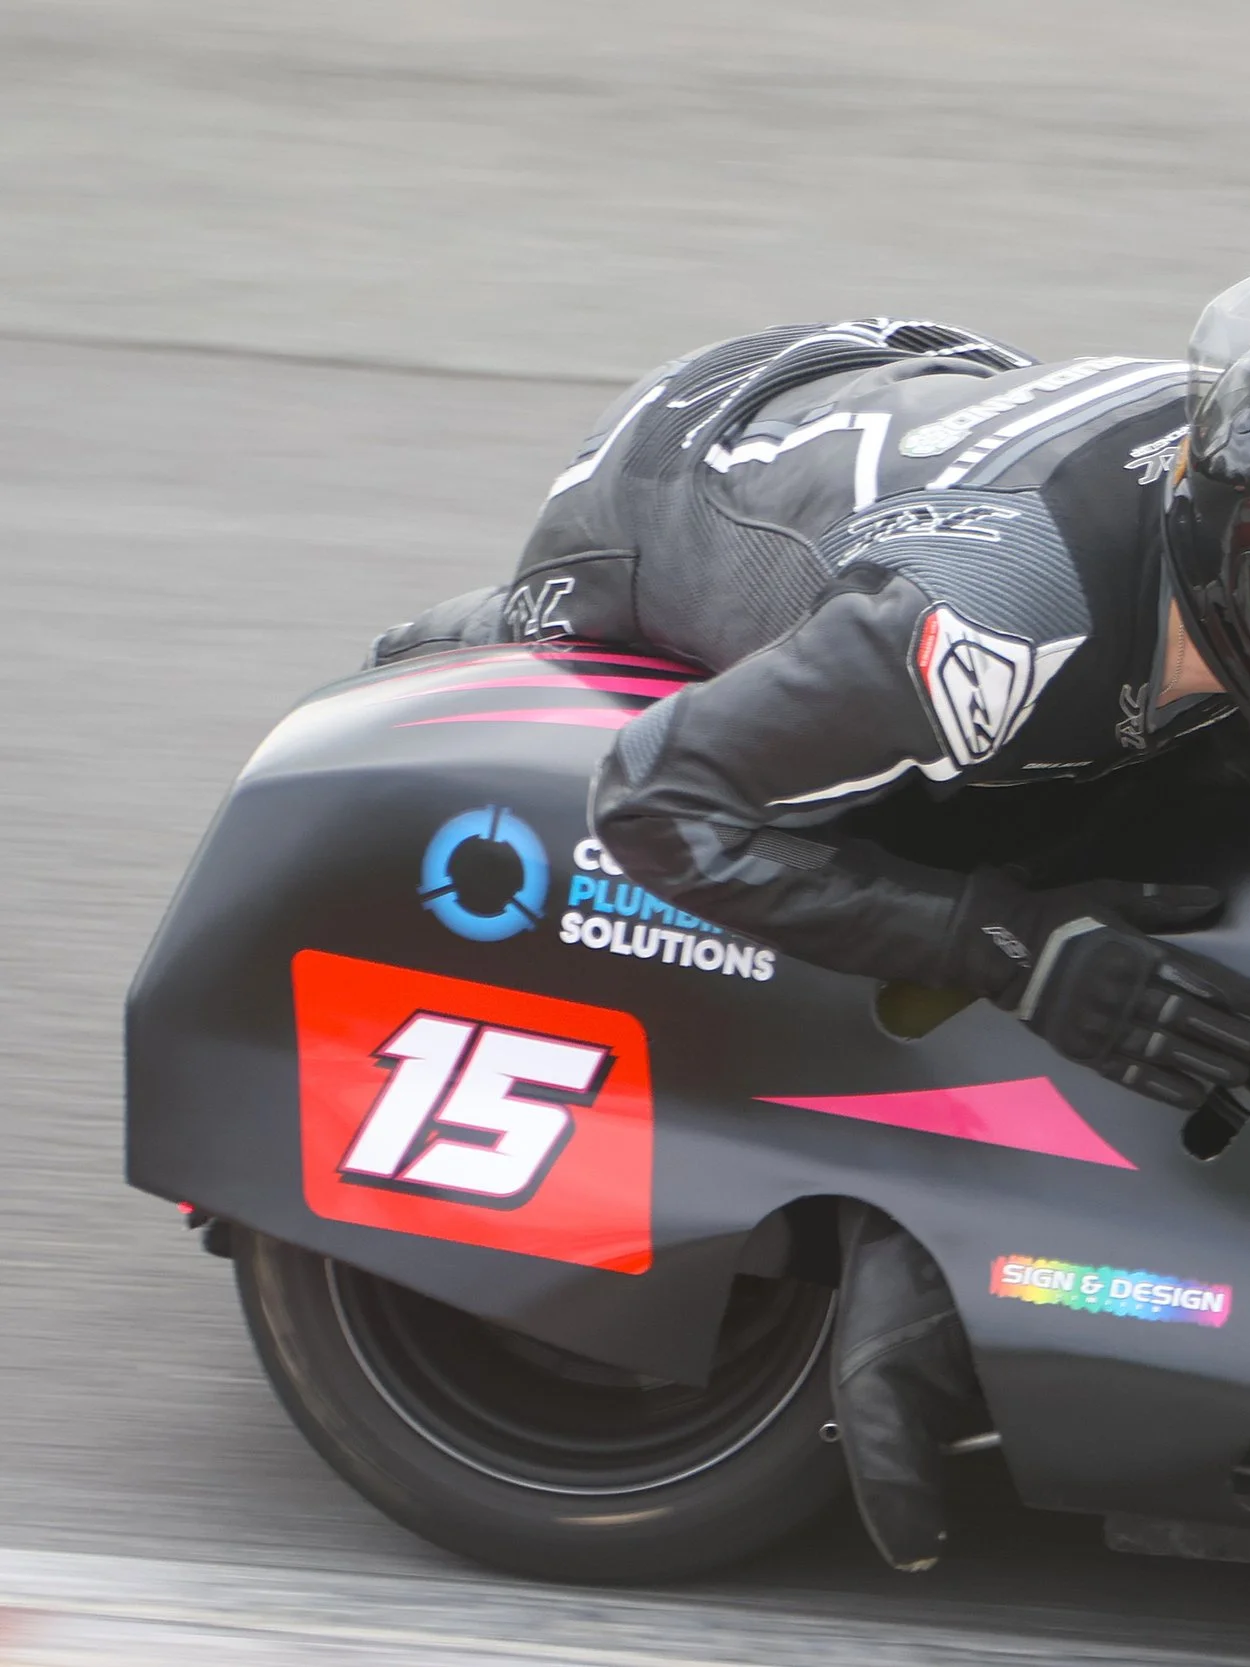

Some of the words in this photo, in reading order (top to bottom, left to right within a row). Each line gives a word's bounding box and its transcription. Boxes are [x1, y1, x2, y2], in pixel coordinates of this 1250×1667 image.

[559, 911, 776, 982] SOLUTIONS
[335, 1009, 613, 1203] 15
[1000, 1263, 1077, 1291] SIGN
[1080, 1274, 1105, 1295] &
[1108, 1278, 1226, 1313] DESIGN
